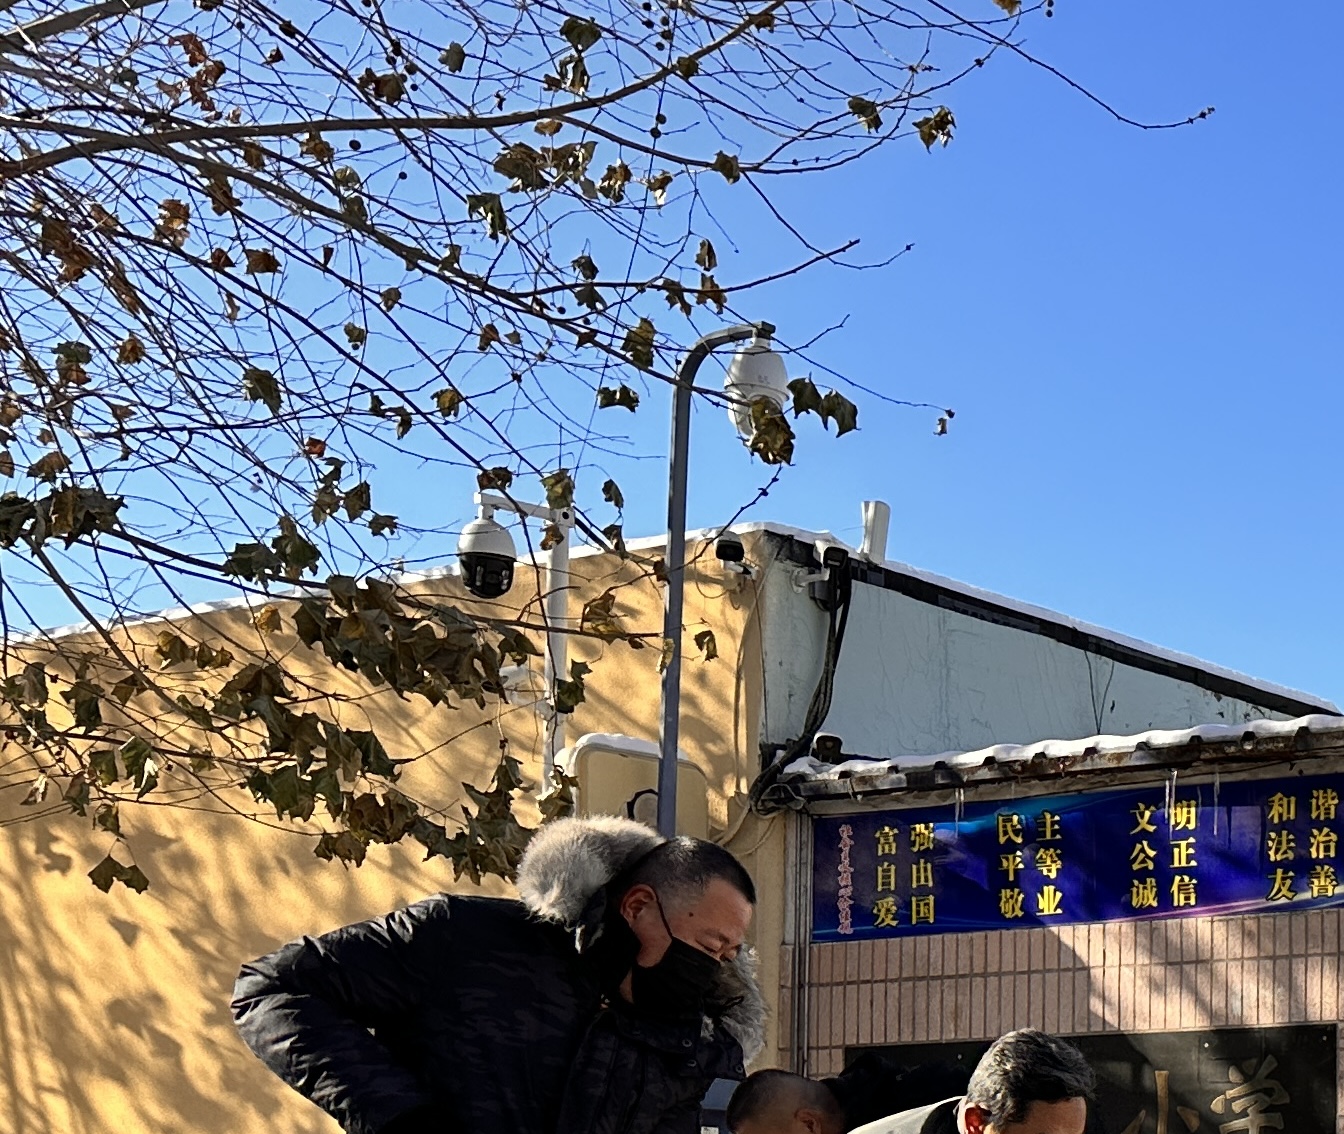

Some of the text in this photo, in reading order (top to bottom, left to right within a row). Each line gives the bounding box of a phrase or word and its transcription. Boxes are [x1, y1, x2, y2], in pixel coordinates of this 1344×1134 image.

[874, 789, 1339, 857] 富强 民主 文明 和谐
[877, 827, 1338, 892] 自由 平等 公正 法治
[873, 864, 1338, 928] 爱国 敬业 诚信 友善
